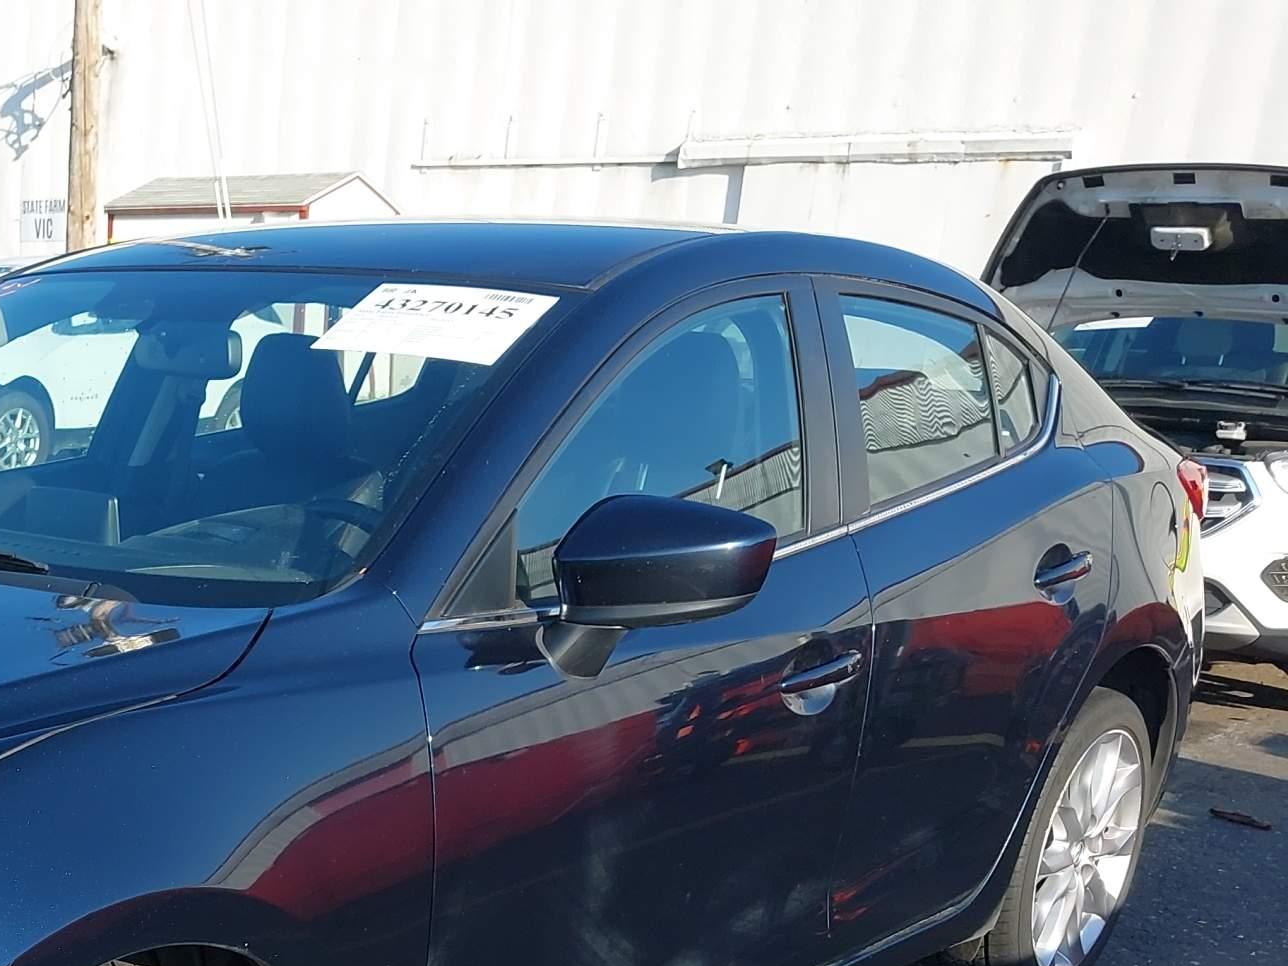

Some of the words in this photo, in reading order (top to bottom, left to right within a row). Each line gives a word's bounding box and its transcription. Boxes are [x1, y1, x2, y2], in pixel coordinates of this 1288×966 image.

[23, 200, 42, 214] STATE
[45, 200, 66, 214] FARM
[34, 218, 53, 238] VIC
[374, 297, 519, 319] 43270145
